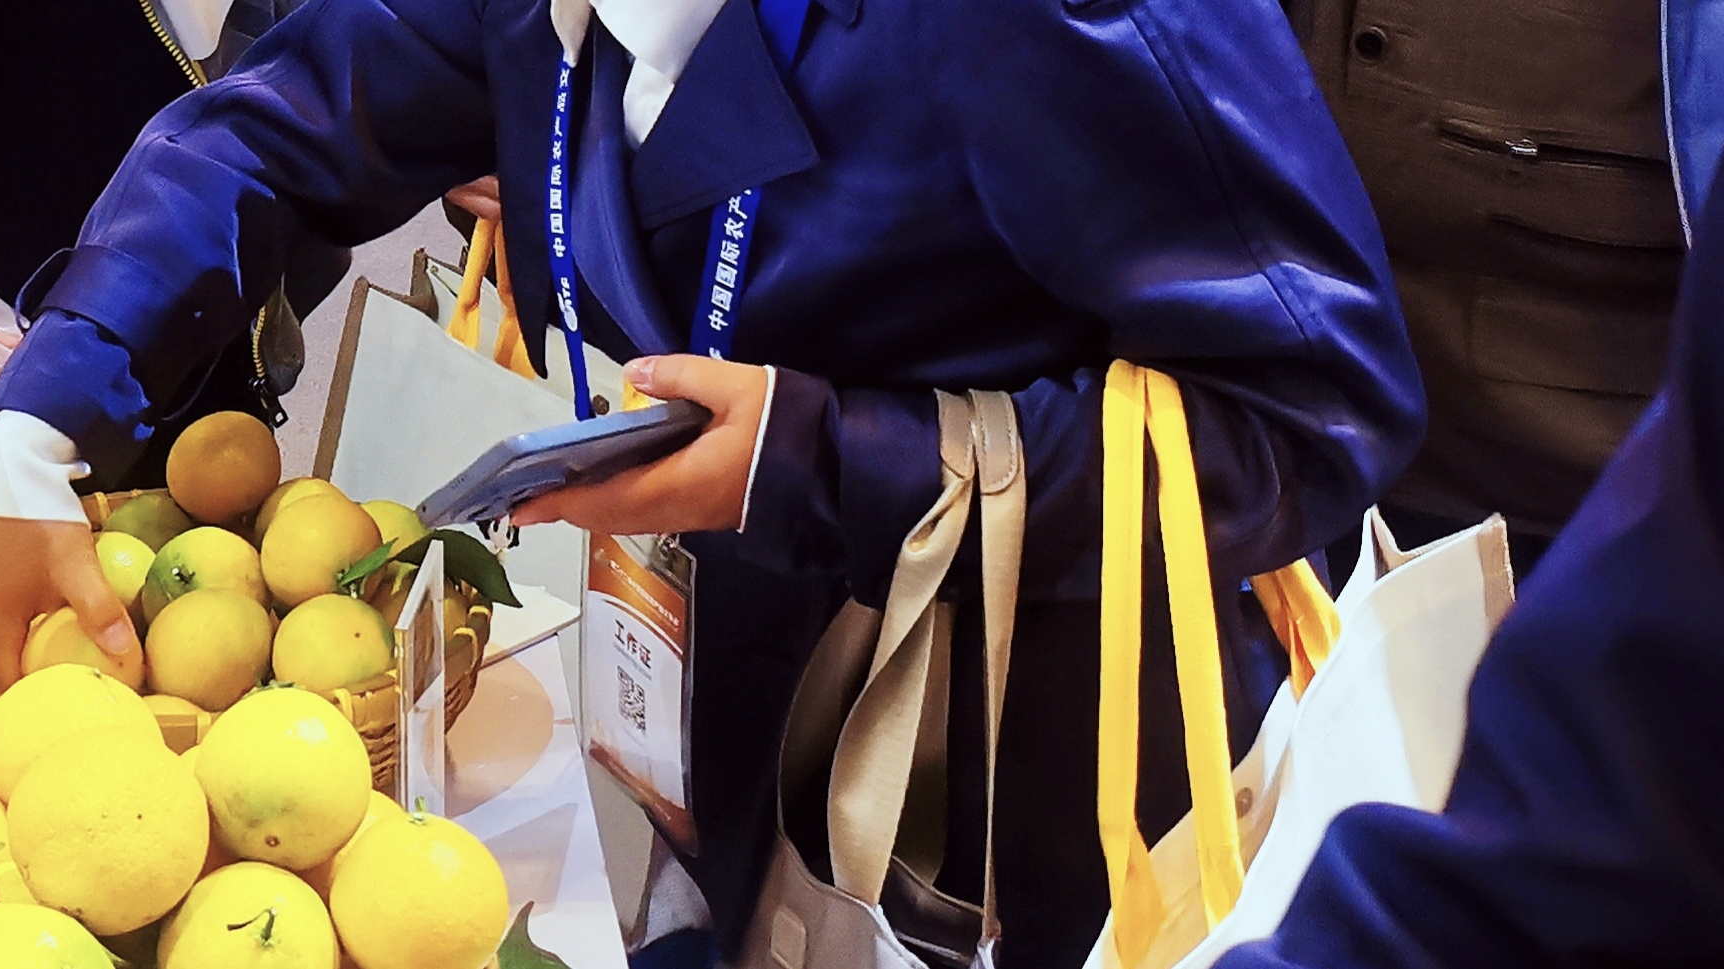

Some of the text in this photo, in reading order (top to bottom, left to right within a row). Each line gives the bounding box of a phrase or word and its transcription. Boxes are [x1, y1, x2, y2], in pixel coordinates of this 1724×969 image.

[708, 189, 752, 331] 中国国际农产
[614, 618, 651, 669] 工作证
